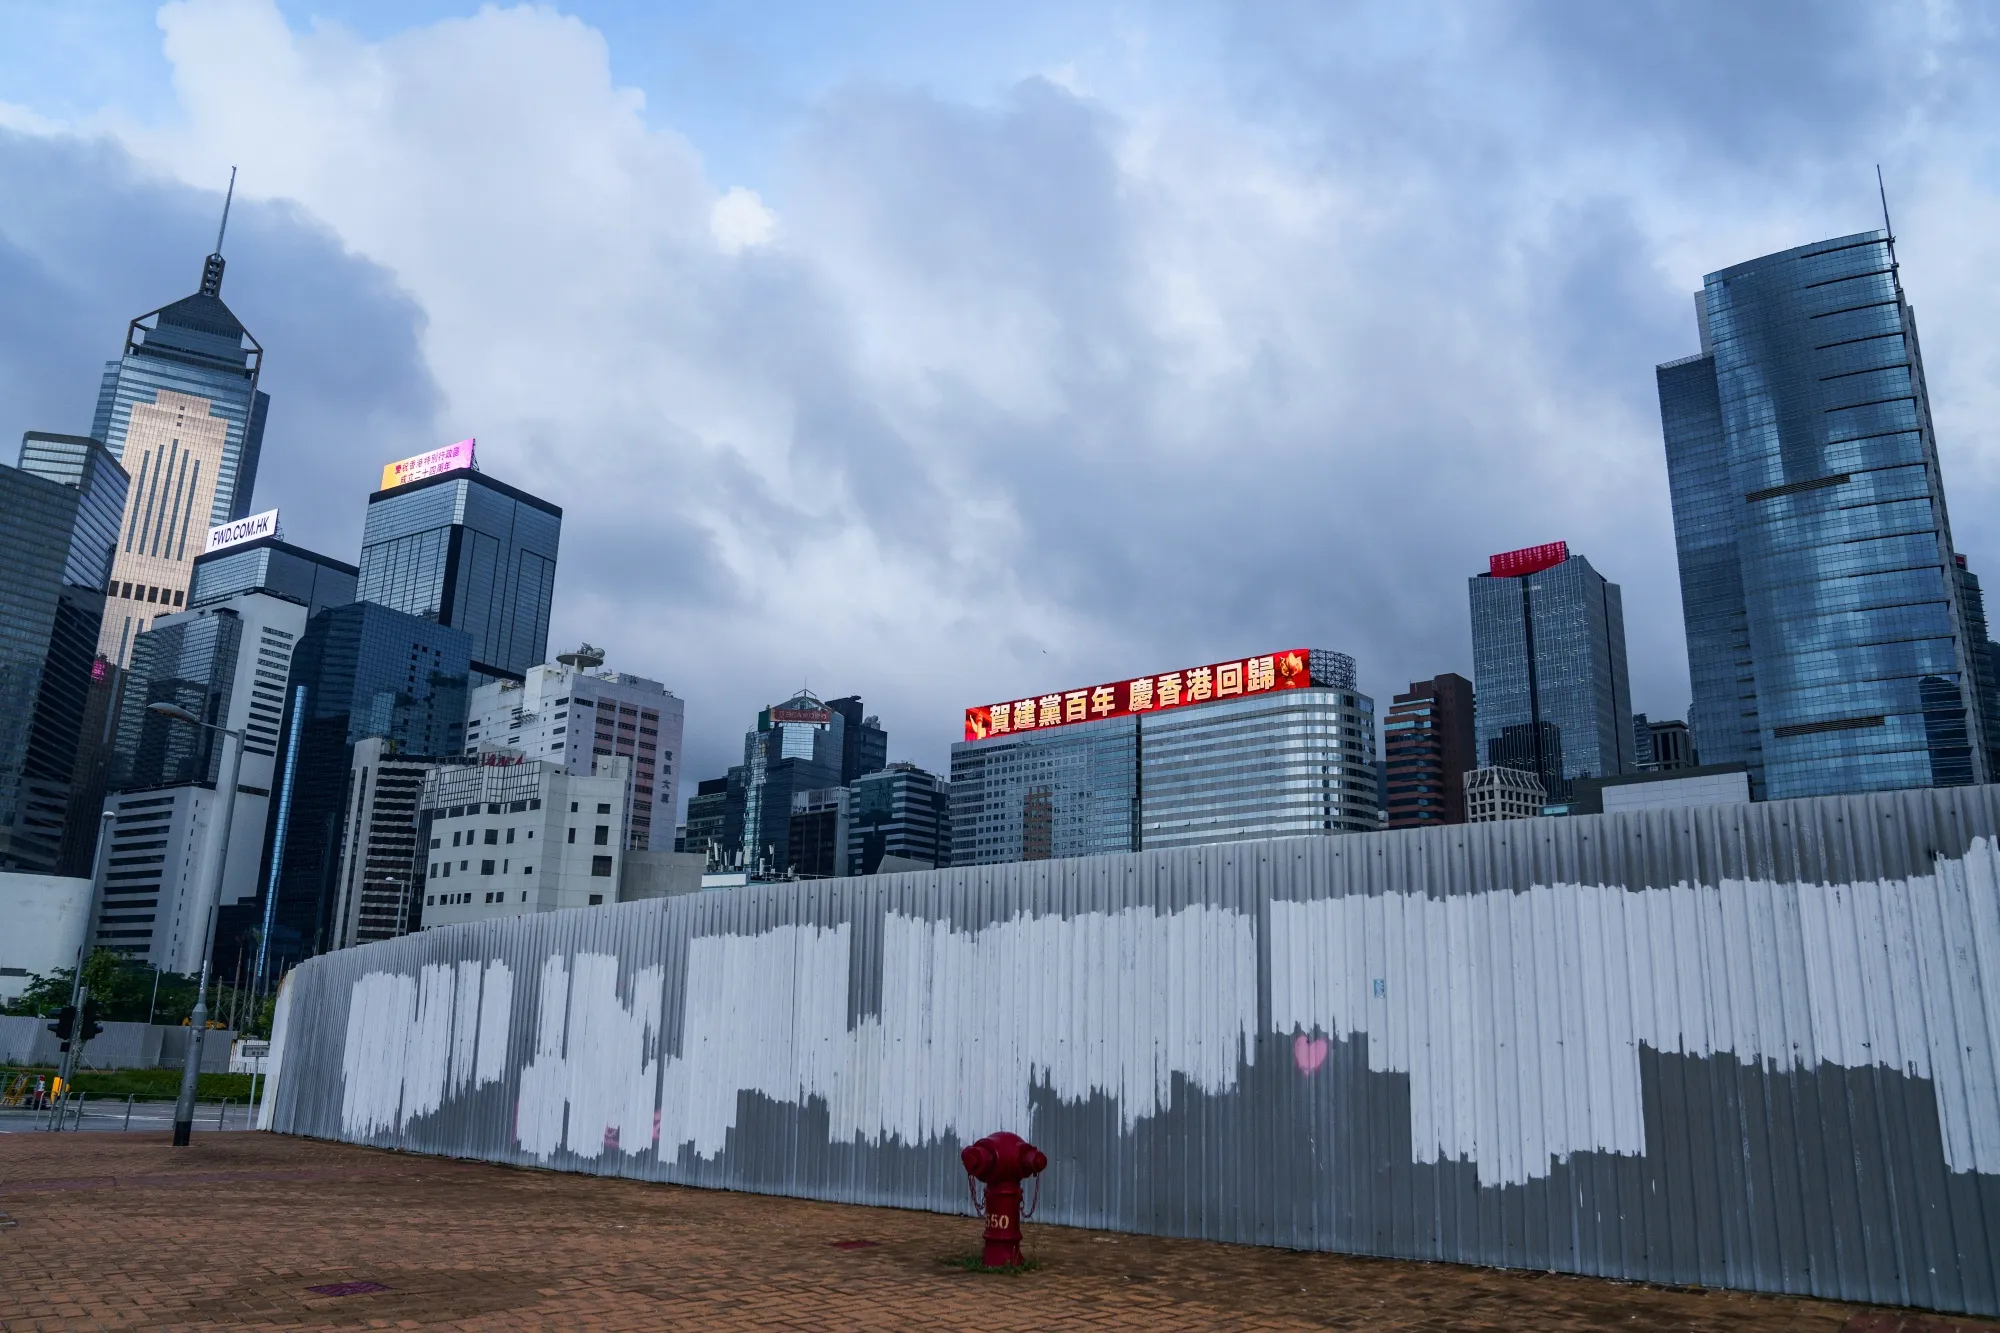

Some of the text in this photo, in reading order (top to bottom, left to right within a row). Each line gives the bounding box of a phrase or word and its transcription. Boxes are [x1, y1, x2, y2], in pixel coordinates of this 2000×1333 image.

[394, 446, 460, 475] 慶祝香港特別行政區
[212, 516, 270, 547] FWD.COM.HK
[989, 656, 1276, 735] 賀建黨百年 慶香港回歸
